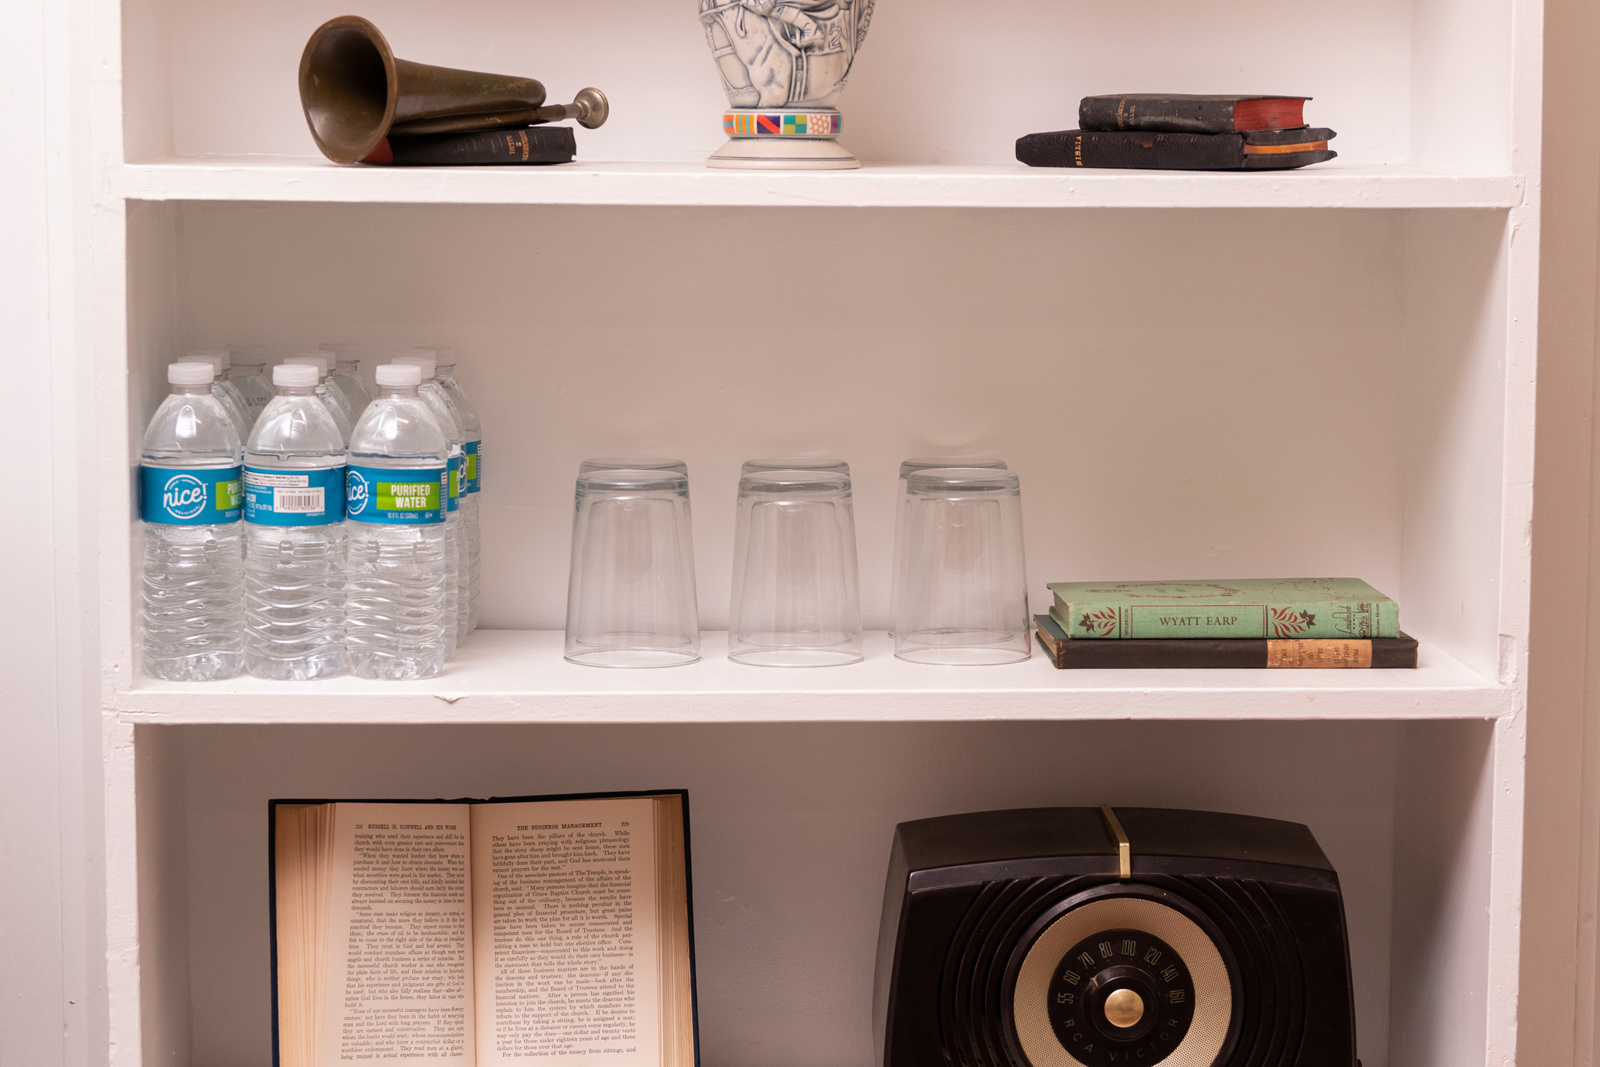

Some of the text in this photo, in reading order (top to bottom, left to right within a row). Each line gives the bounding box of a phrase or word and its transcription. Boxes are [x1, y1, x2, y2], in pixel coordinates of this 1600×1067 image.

[1074, 135, 1083, 166] BIBLIA
[163, 483, 208, 508] nice!
[390, 484, 431, 496] PURIFIED
[395, 496, 427, 508] WATER
[1159, 616, 1238, 626] WYATT EARP
[1098, 941, 1113, 959] 80
[1121, 939, 1137, 957] 100
[1143, 946, 1162, 966] 120
[1077, 951, 1095, 970] 70
[1063, 969, 1081, 986] 60
[1160, 963, 1180, 983] 140
[1057, 992, 1074, 1005] 55
[1169, 988, 1185, 1004] 160
[1064, 1018, 1179, 1061] RCA VICTOR
